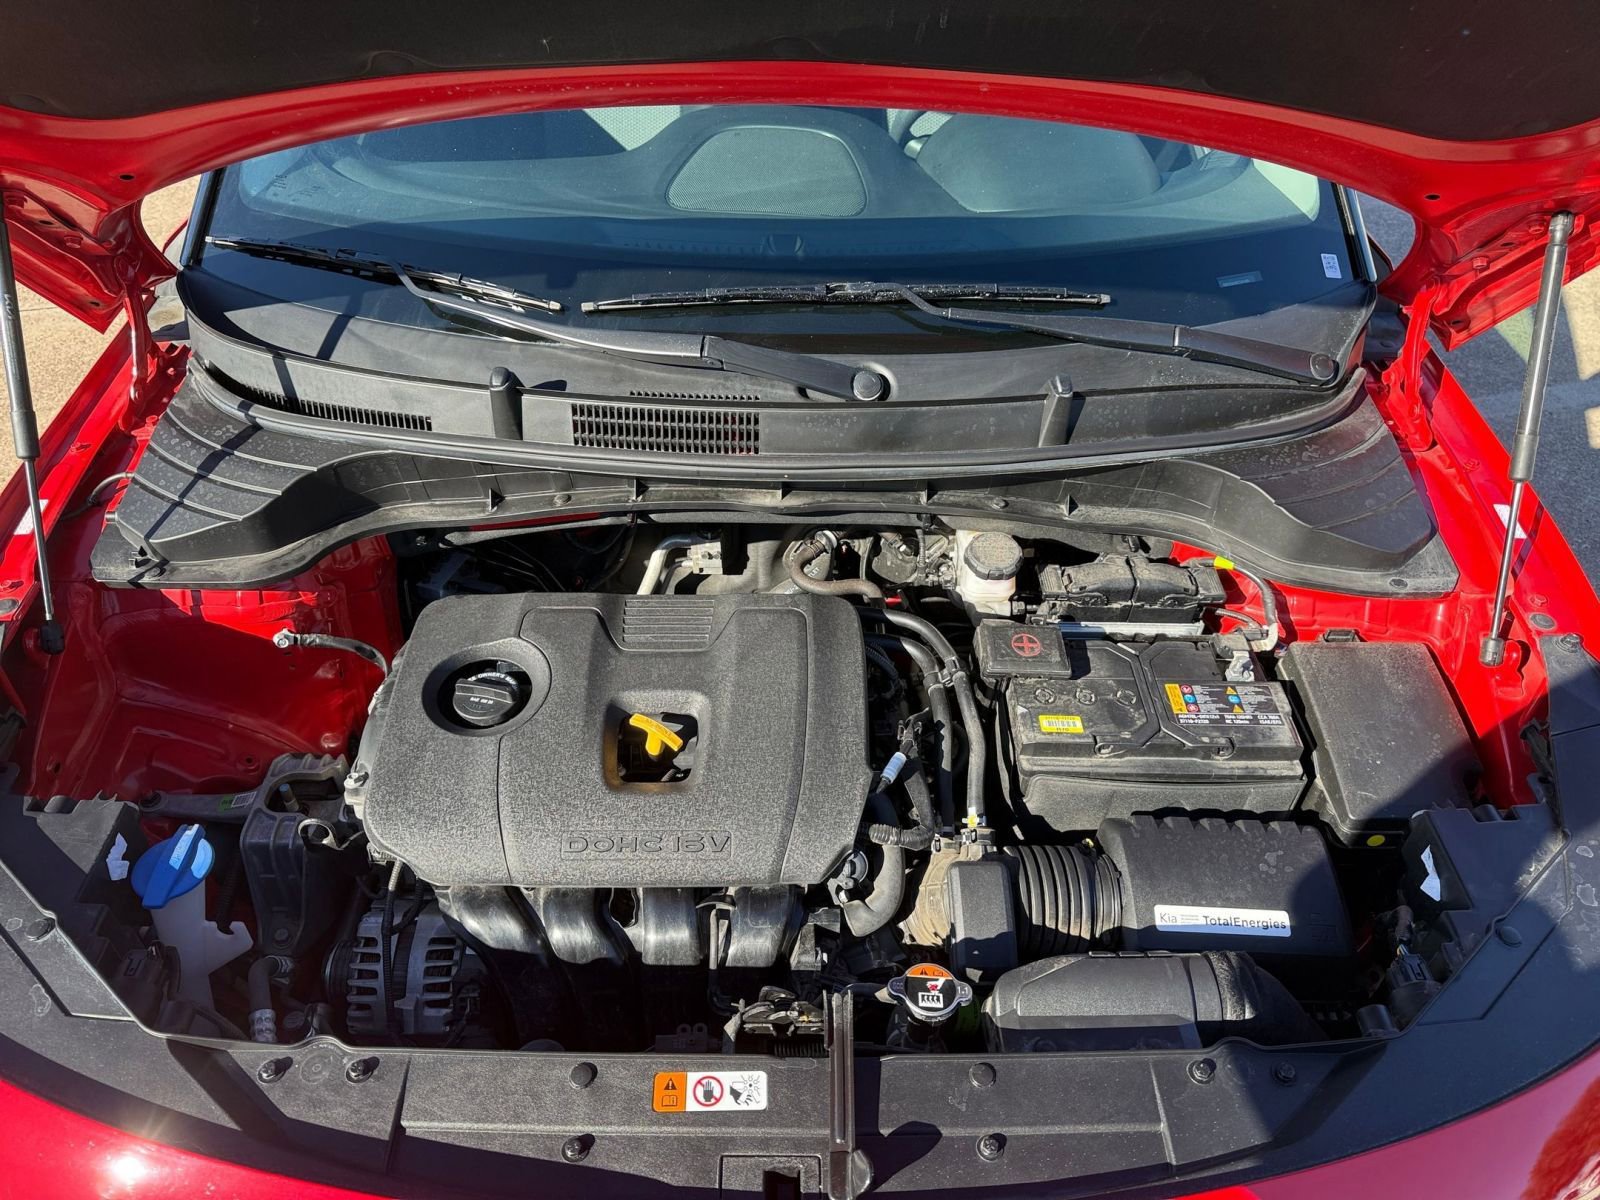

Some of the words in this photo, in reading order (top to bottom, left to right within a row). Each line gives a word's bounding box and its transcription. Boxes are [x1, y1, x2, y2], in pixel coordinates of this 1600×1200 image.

[563, 836, 663, 853] DOHC
[672, 836, 731, 853] 16V
[1160, 911, 1178, 924] Kia
[1202, 915, 1287, 930] TotalEnergies
[957, 985, 969, 995] 1.1
